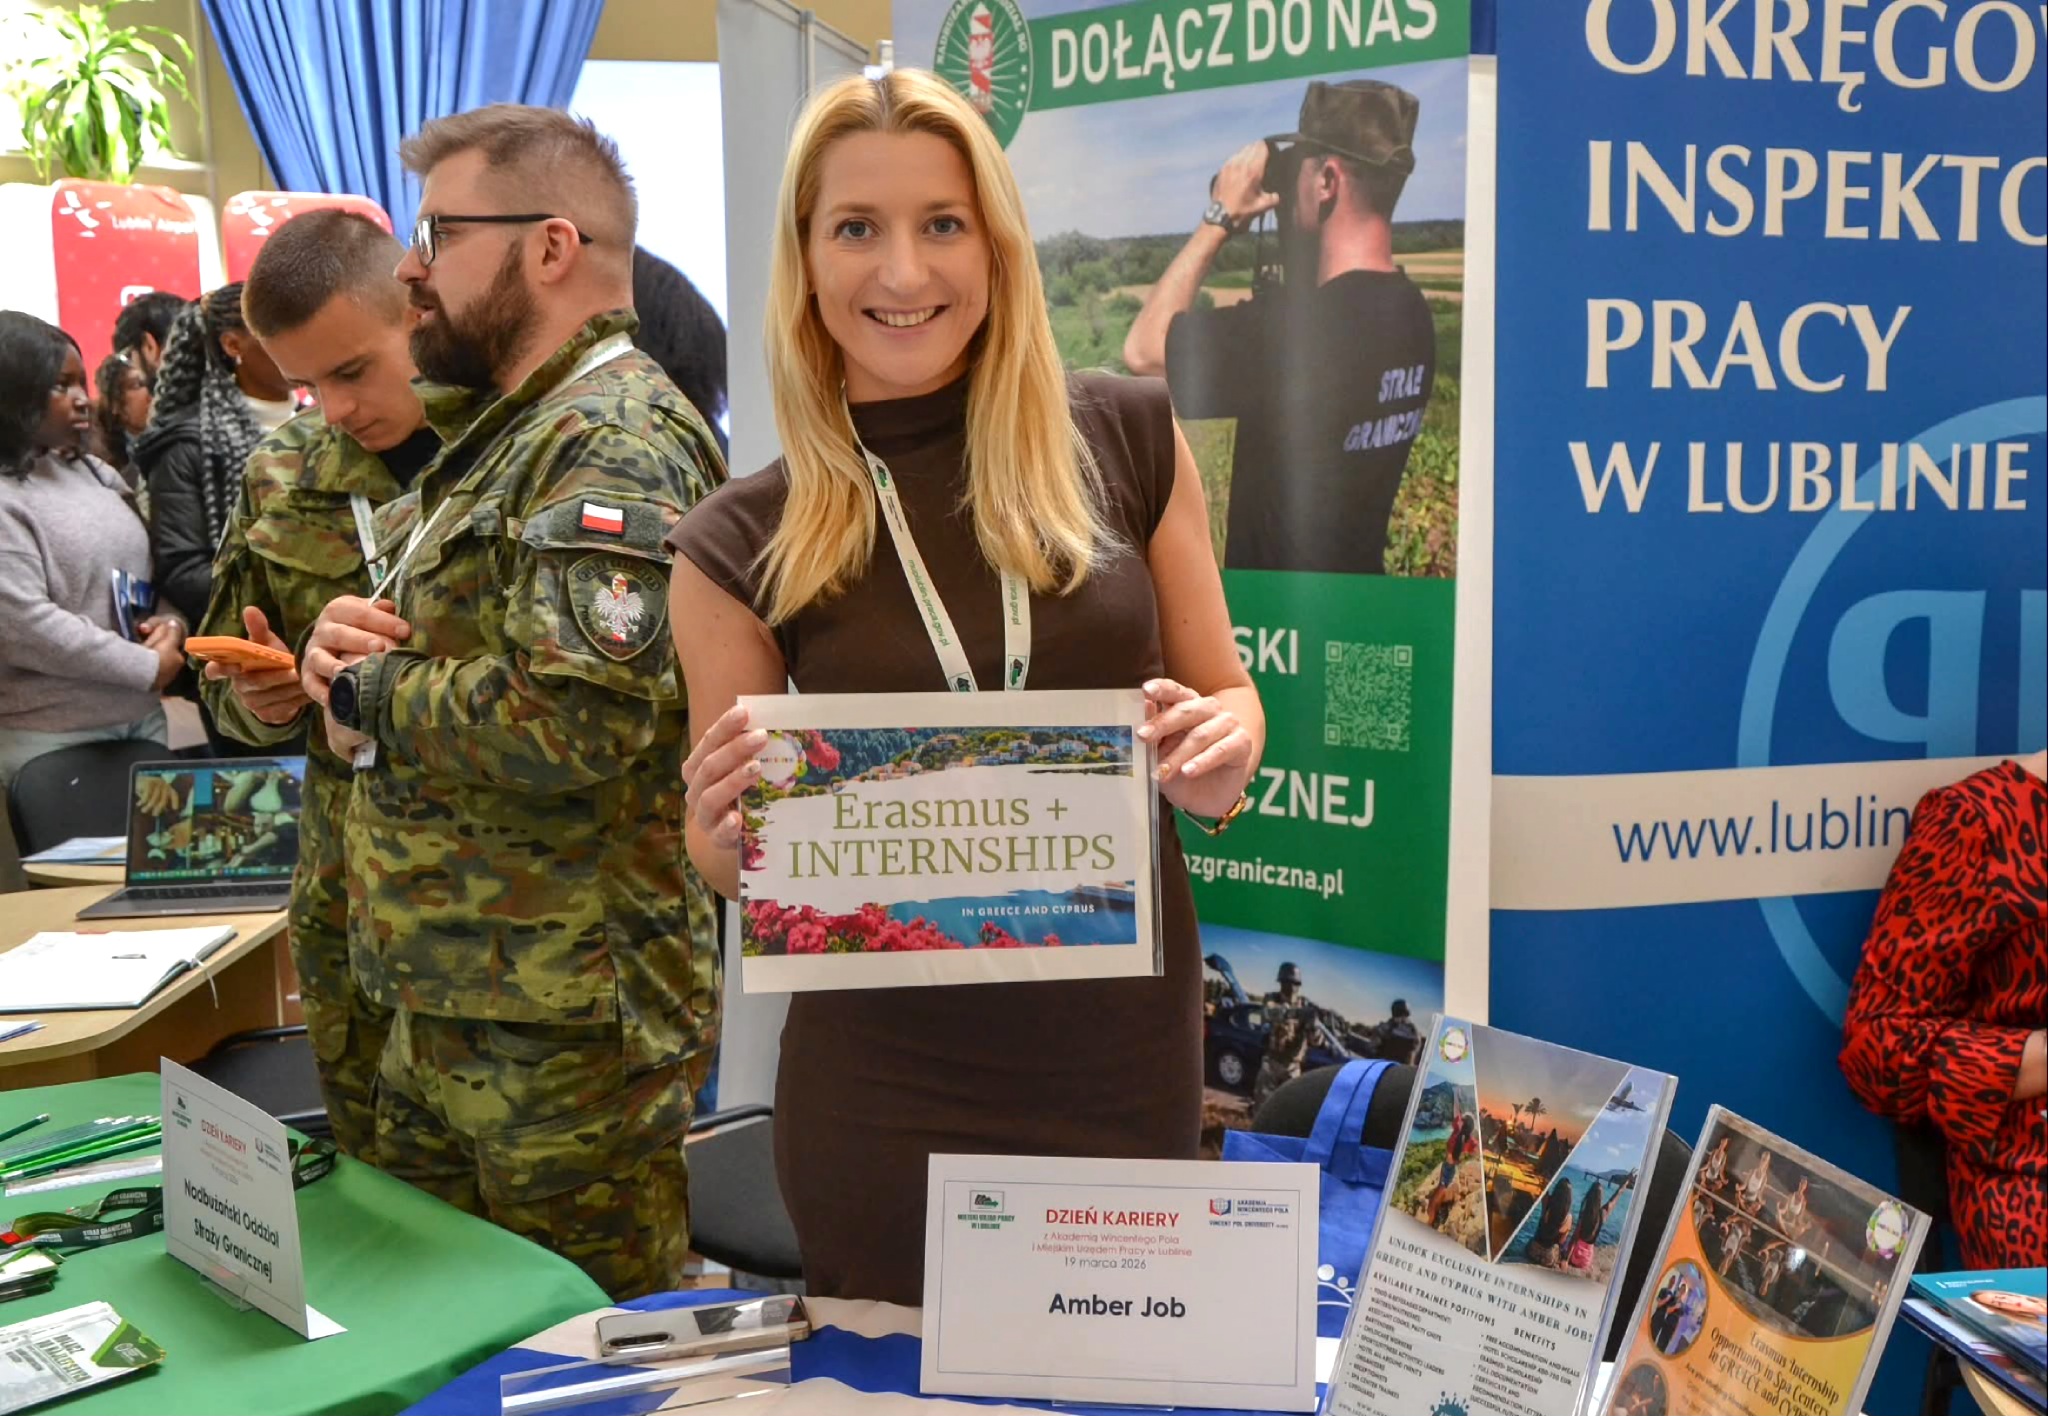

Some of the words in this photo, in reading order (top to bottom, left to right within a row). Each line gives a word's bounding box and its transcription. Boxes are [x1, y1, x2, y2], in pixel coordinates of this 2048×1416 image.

[1052, 4, 1234, 89] DOŁĄCZ
[1246, 0, 1312, 63] DO
[1327, 0, 1439, 52] NAS
[1585, 0, 2048, 112] OKRĘGO
[111, 214, 152, 231] Lublin
[1586, 298, 1912, 392] PRACY
[1568, 441, 1661, 513] W
[1688, 441, 2029, 513] LUBLINIE
[1230, 626, 1298, 675] SKI
[832, 792, 1031, 830] Erasmus
[1045, 797, 1069, 822] +
[1613, 794, 1911, 863] www.lublin
[788, 833, 1115, 879] INTERNSHIPS
[962, 908, 974, 917] IN
[978, 906, 1020, 917] GREECE
[1024, 905, 1048, 915] AND
[1052, 904, 1095, 914] CYPRUS
[1046, 1205, 1098, 1225] DZIEŃ
[1103, 1210, 1179, 1228] KARIERY
[1050, 1231, 1099, 1243] Akademią
[1101, 1233, 1157, 1245] Wincentego
[1158, 1234, 1180, 1245] Pola
[222, 1235, 272, 1284] Granicznej
[1064, 1256, 1076, 1268] 19
[1079, 1258, 1117, 1269] marca
[1121, 1258, 1147, 1270] 2026
[1119, 1246, 1145, 1257] Pracy
[1158, 1247, 1193, 1257] Lublinie
[1373, 1271, 1413, 1293] AVAILABLE
[1415, 1287, 1448, 1307] TRAINEE
[1450, 1302, 1495, 1326] POSITIONS
[1375, 1250, 1413, 1272] GREECE
[1416, 1266, 1437, 1282] AND
[1440, 1275, 1483, 1299] CYPRUS
[1486, 1293, 1516, 1312] WITH
[1519, 1306, 1561, 1330] AMBER
[1388, 1235, 1428, 1258] UNLOCK
[1430, 1251, 1491, 1282] EXCLUSIVE
[1493, 1275, 1571, 1313] INTERNSHIPS
[1574, 1305, 1588, 1319] IN
[1048, 1293, 1133, 1316] Amber
[1140, 1296, 1186, 1318] Job
[1513, 1327, 1556, 1351] BENEFITS
[1789, 1358, 1839, 1405] Internship
